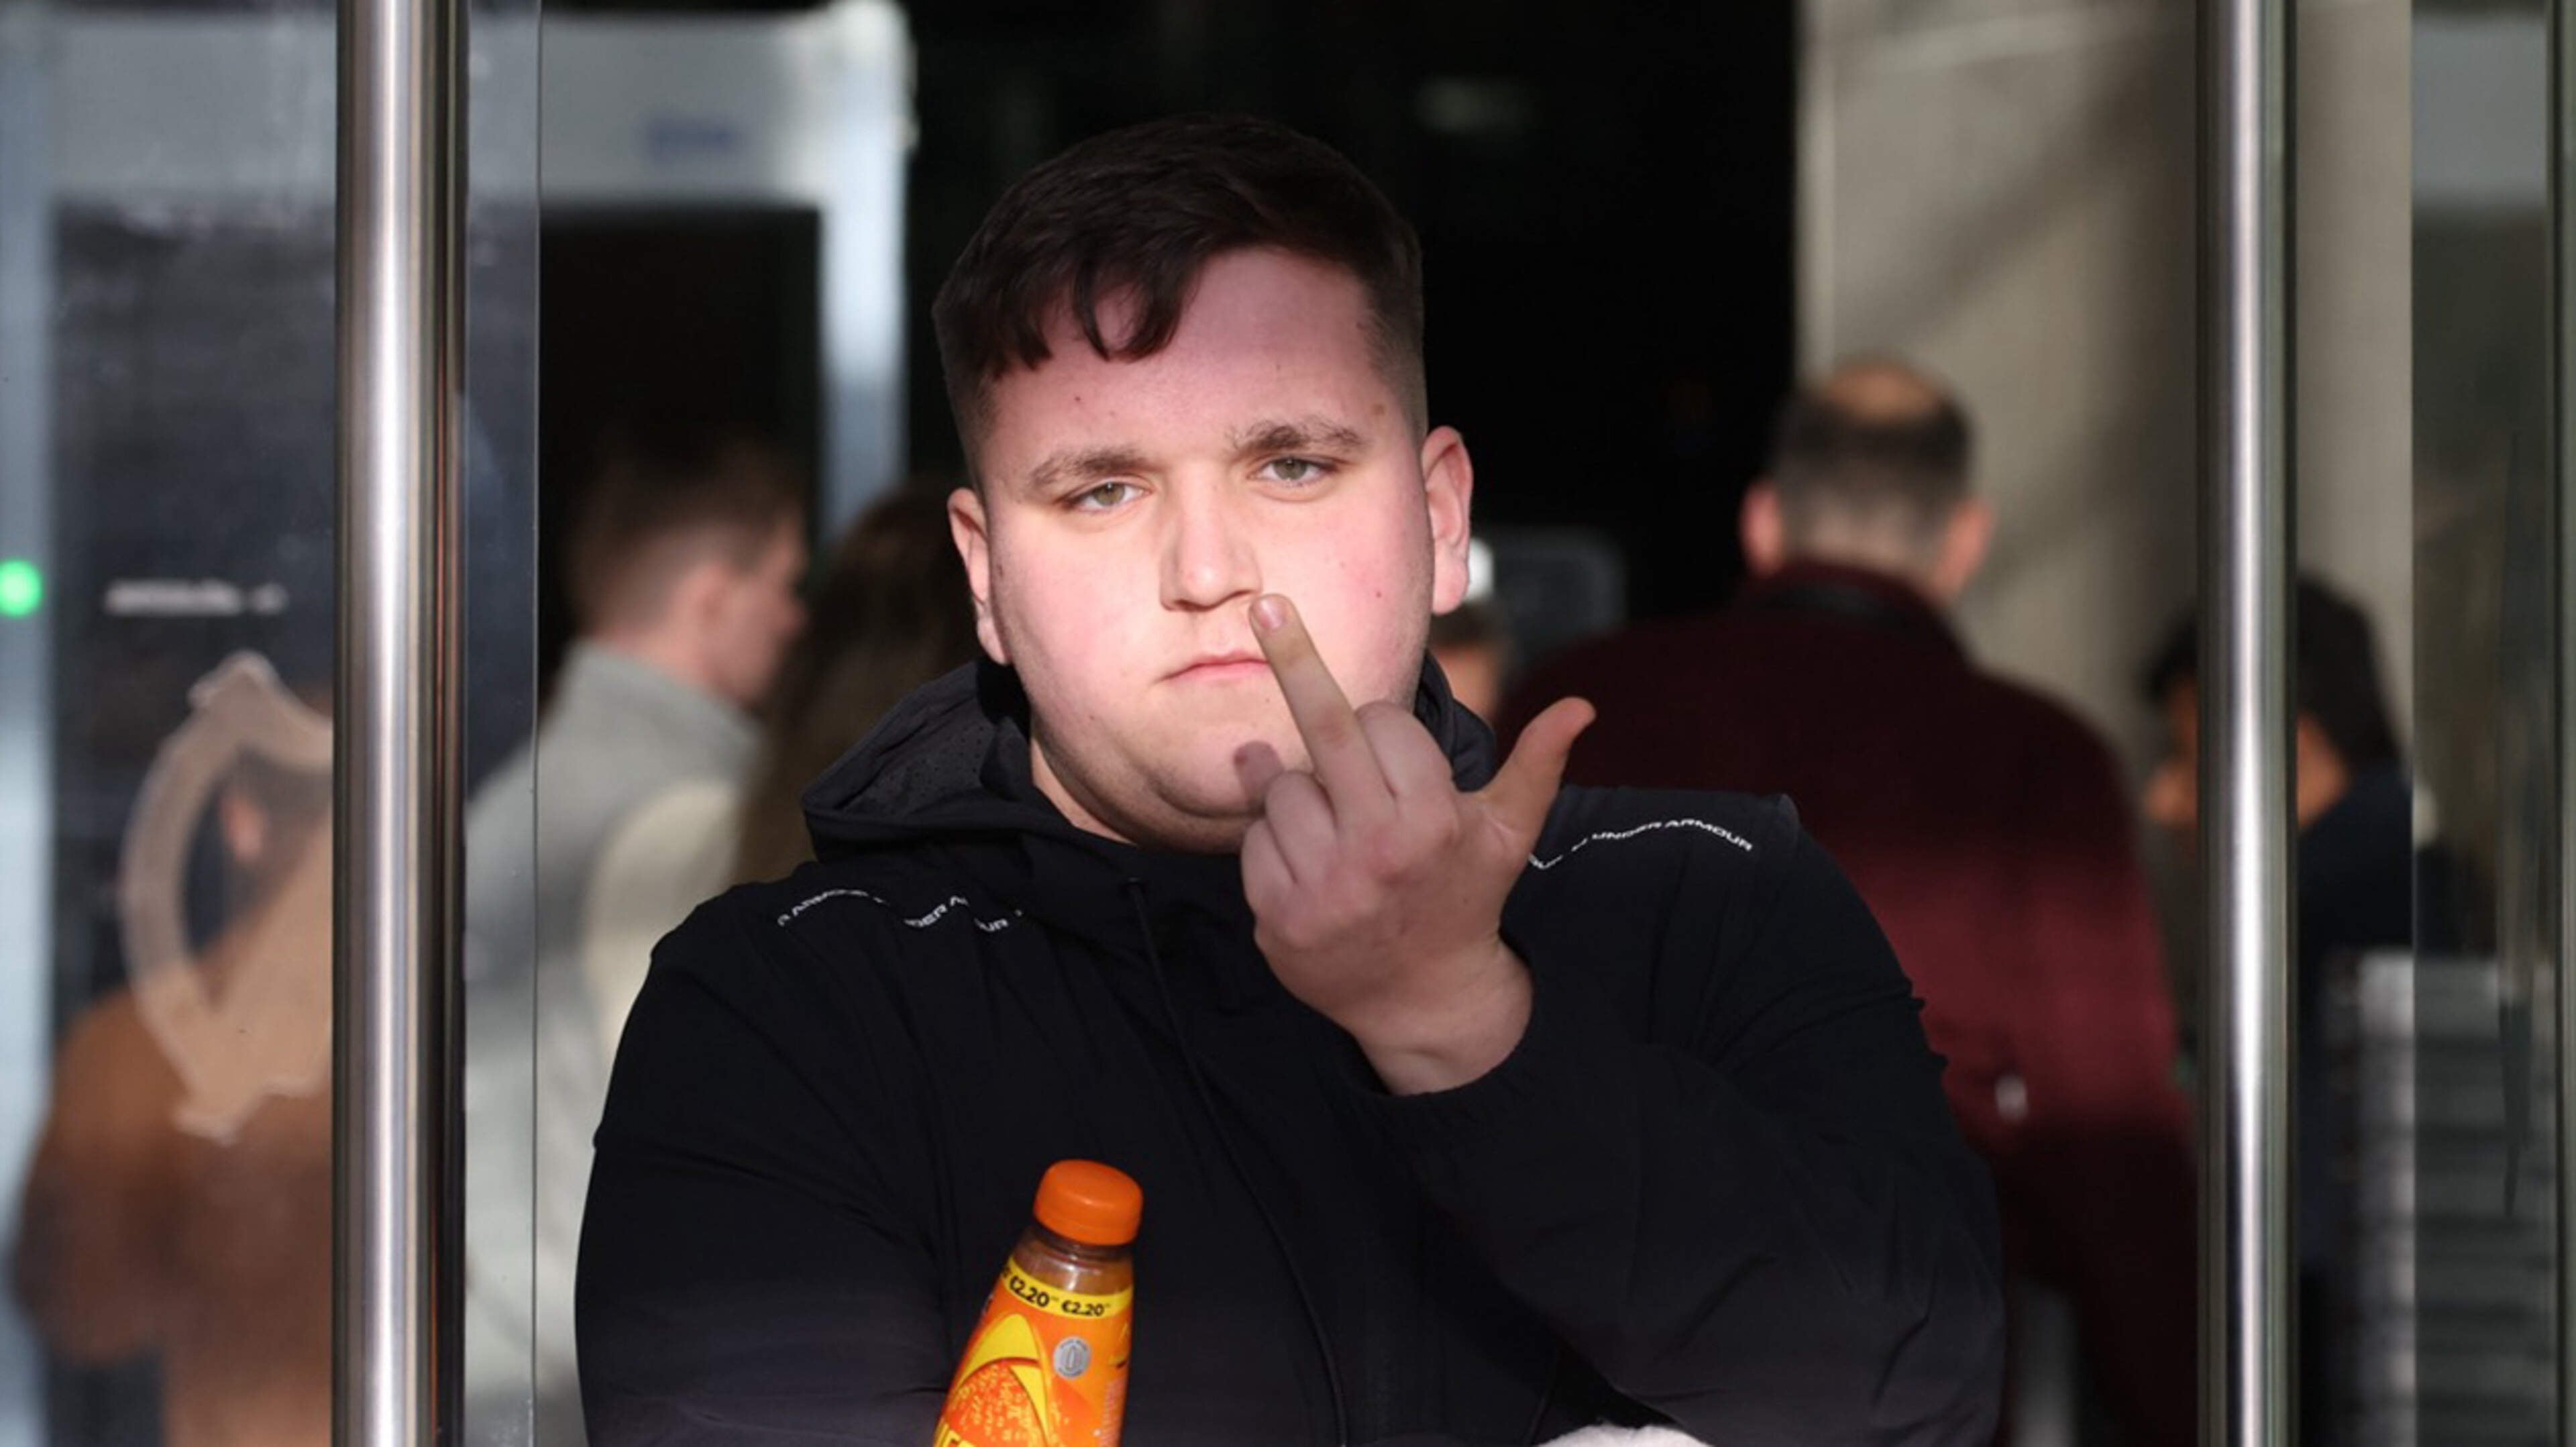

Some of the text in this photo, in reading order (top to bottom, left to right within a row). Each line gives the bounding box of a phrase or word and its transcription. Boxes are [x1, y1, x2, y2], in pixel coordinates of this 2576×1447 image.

[1592, 818, 1753, 851] UNDER ARMOUR
[1061, 1300, 1105, 1317] €2.20
